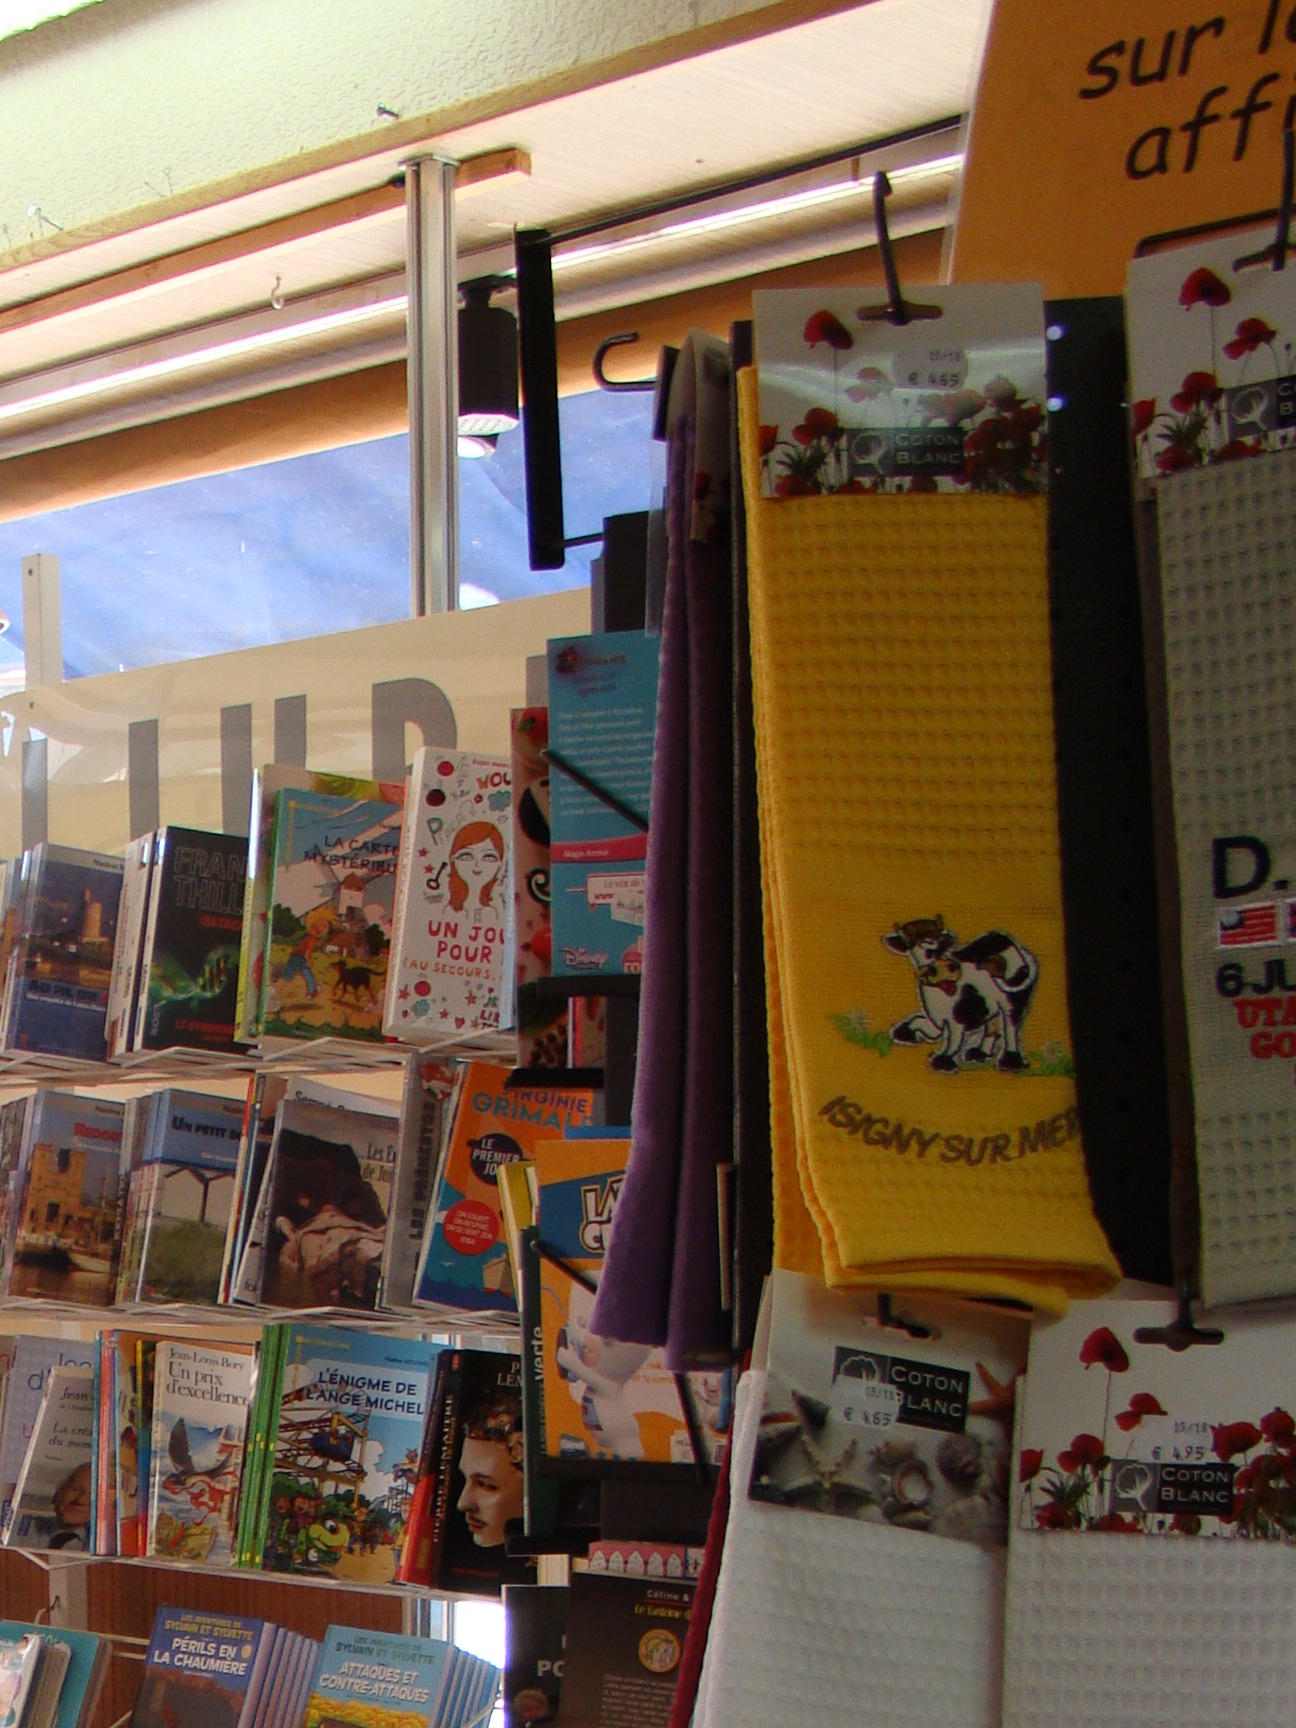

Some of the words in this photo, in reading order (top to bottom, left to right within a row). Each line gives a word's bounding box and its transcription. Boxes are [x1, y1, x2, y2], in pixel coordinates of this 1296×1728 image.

[1079, 16, 1225, 100] sur
[896, 450, 960, 465] BLANC
[325, 835, 344, 850] LA
[428, 919, 459, 938] UN
[437, 940, 492, 964] POUR
[818, 1095, 937, 1159] ISIGNY
[941, 1133, 1012, 1165] SUR
[482, 1139, 493, 1150] LE
[168, 1362, 190, 1381] Un
[193, 1365, 224, 1389] prix
[317, 1366, 391, 1393] L'ÉNIGME
[395, 1382, 417, 1396] DE
[890, 1364, 964, 1396] COTON
[364, 1393, 426, 1417] MICHEL
[1161, 1467, 1230, 1485] COTON
[1161, 1486, 1230, 1504] BLANC
[171, 1636, 217, 1658] PÉRILS
[219, 1644, 237, 1658] EN
[153, 1650, 172, 1665] LA
[172, 1653, 248, 1676] CHAUMIÈRE
[339, 1660, 400, 1684] ATTAQUES
[402, 1670, 419, 1684] ET
[318, 1673, 430, 1704] CONTRE-ATTAQUES
